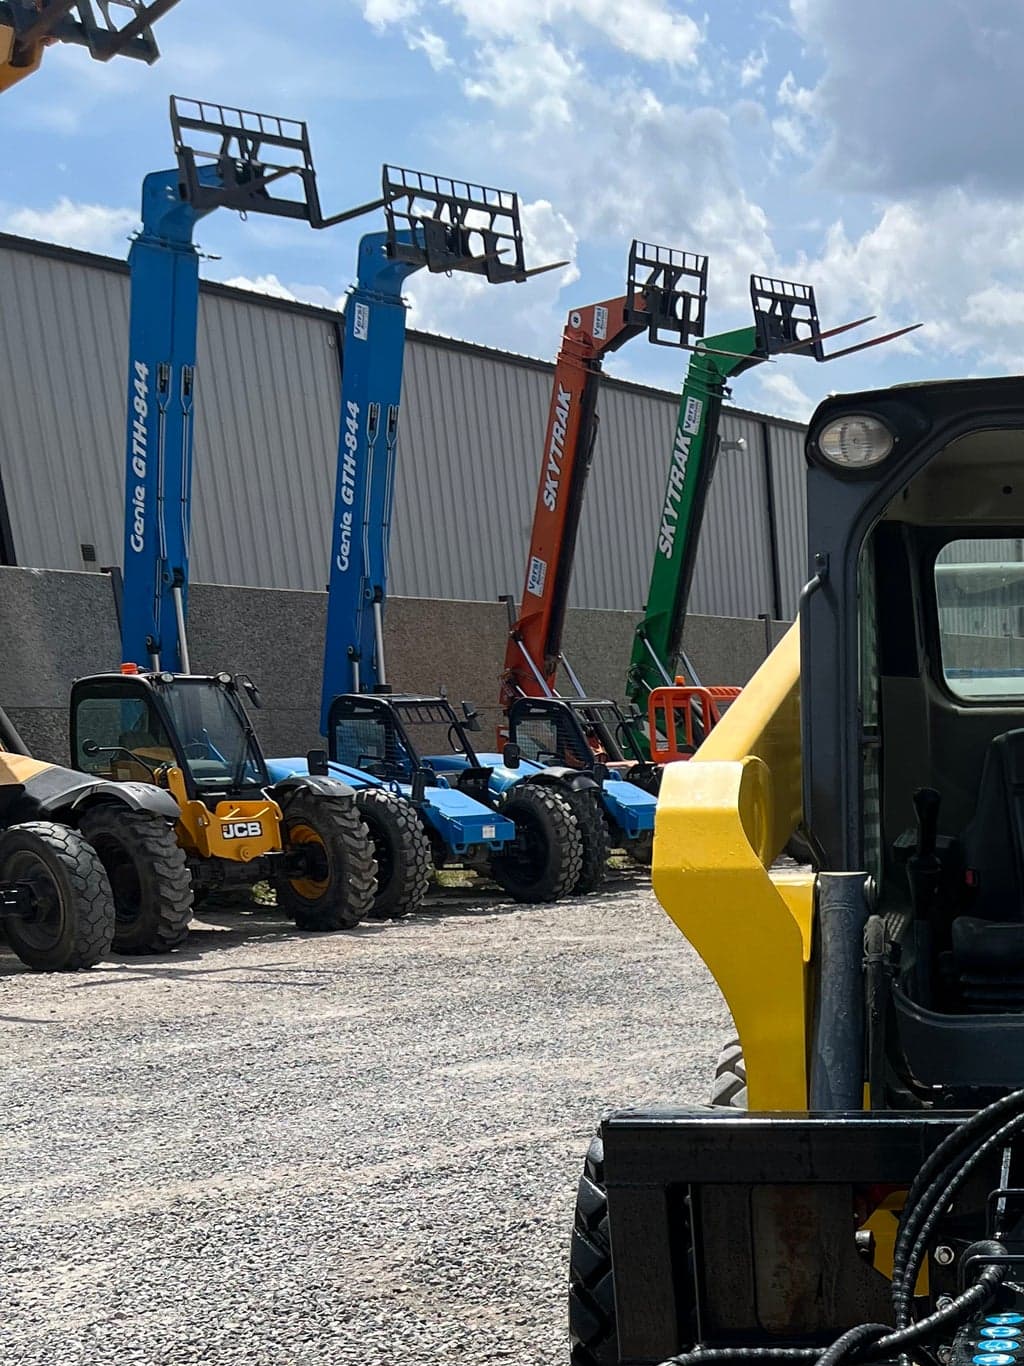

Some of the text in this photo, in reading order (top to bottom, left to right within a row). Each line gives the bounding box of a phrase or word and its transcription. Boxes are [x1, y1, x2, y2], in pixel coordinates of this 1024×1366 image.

[130, 360, 149, 553] Genie GTH-844
[337, 400, 360, 571] Genie GTH-844
[543, 382, 572, 511] SKYTRAK
[659, 427, 692, 559] SKYTRAK
[222, 822, 262, 839] JCB
